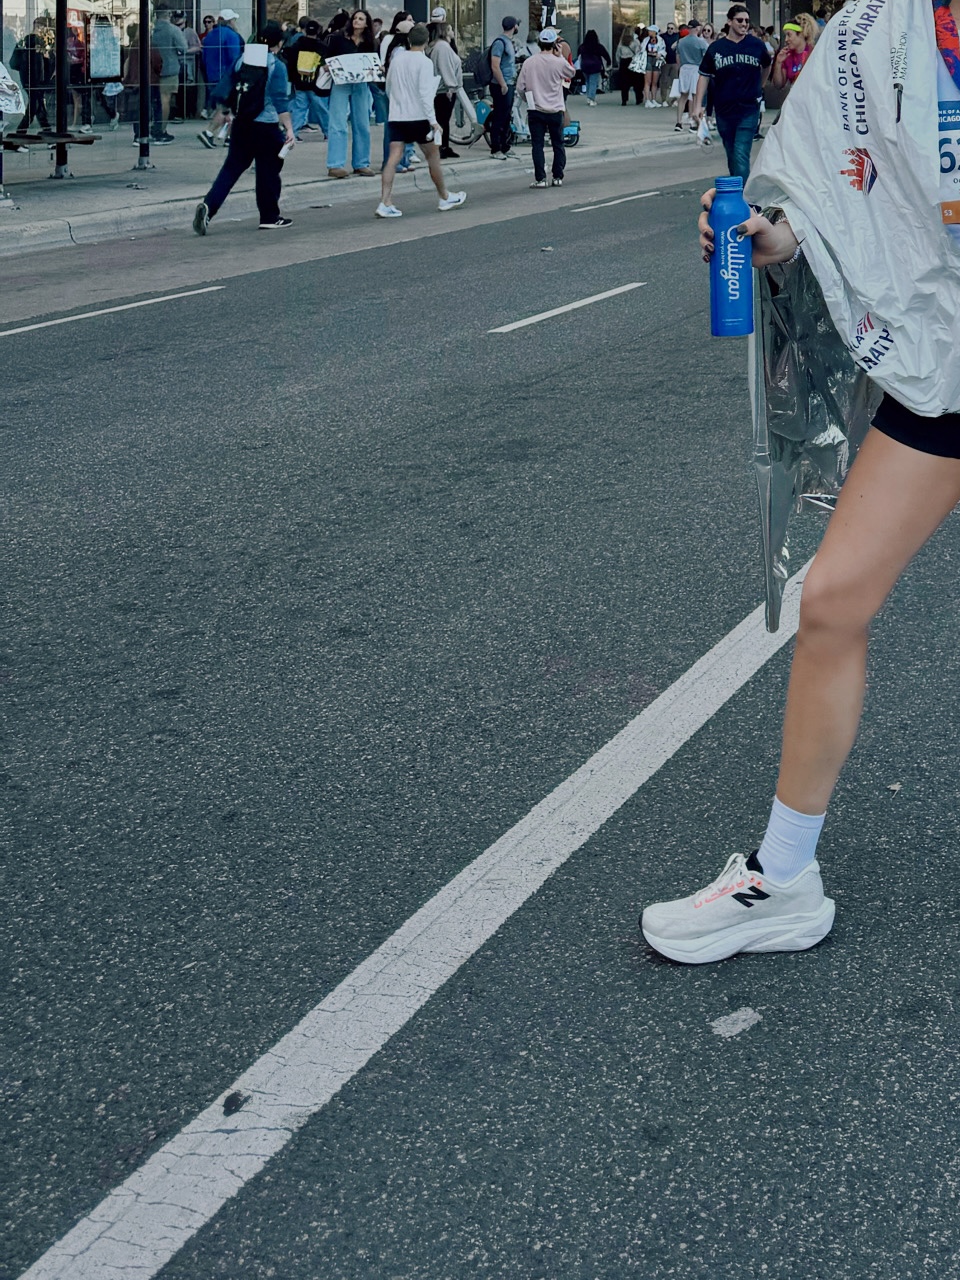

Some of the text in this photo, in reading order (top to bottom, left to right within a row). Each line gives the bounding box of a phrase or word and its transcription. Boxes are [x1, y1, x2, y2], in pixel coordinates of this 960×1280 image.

[838, 67, 848, 87] OF
[839, 92, 851, 132] BANK
[720, 224, 745, 301] Culligan
